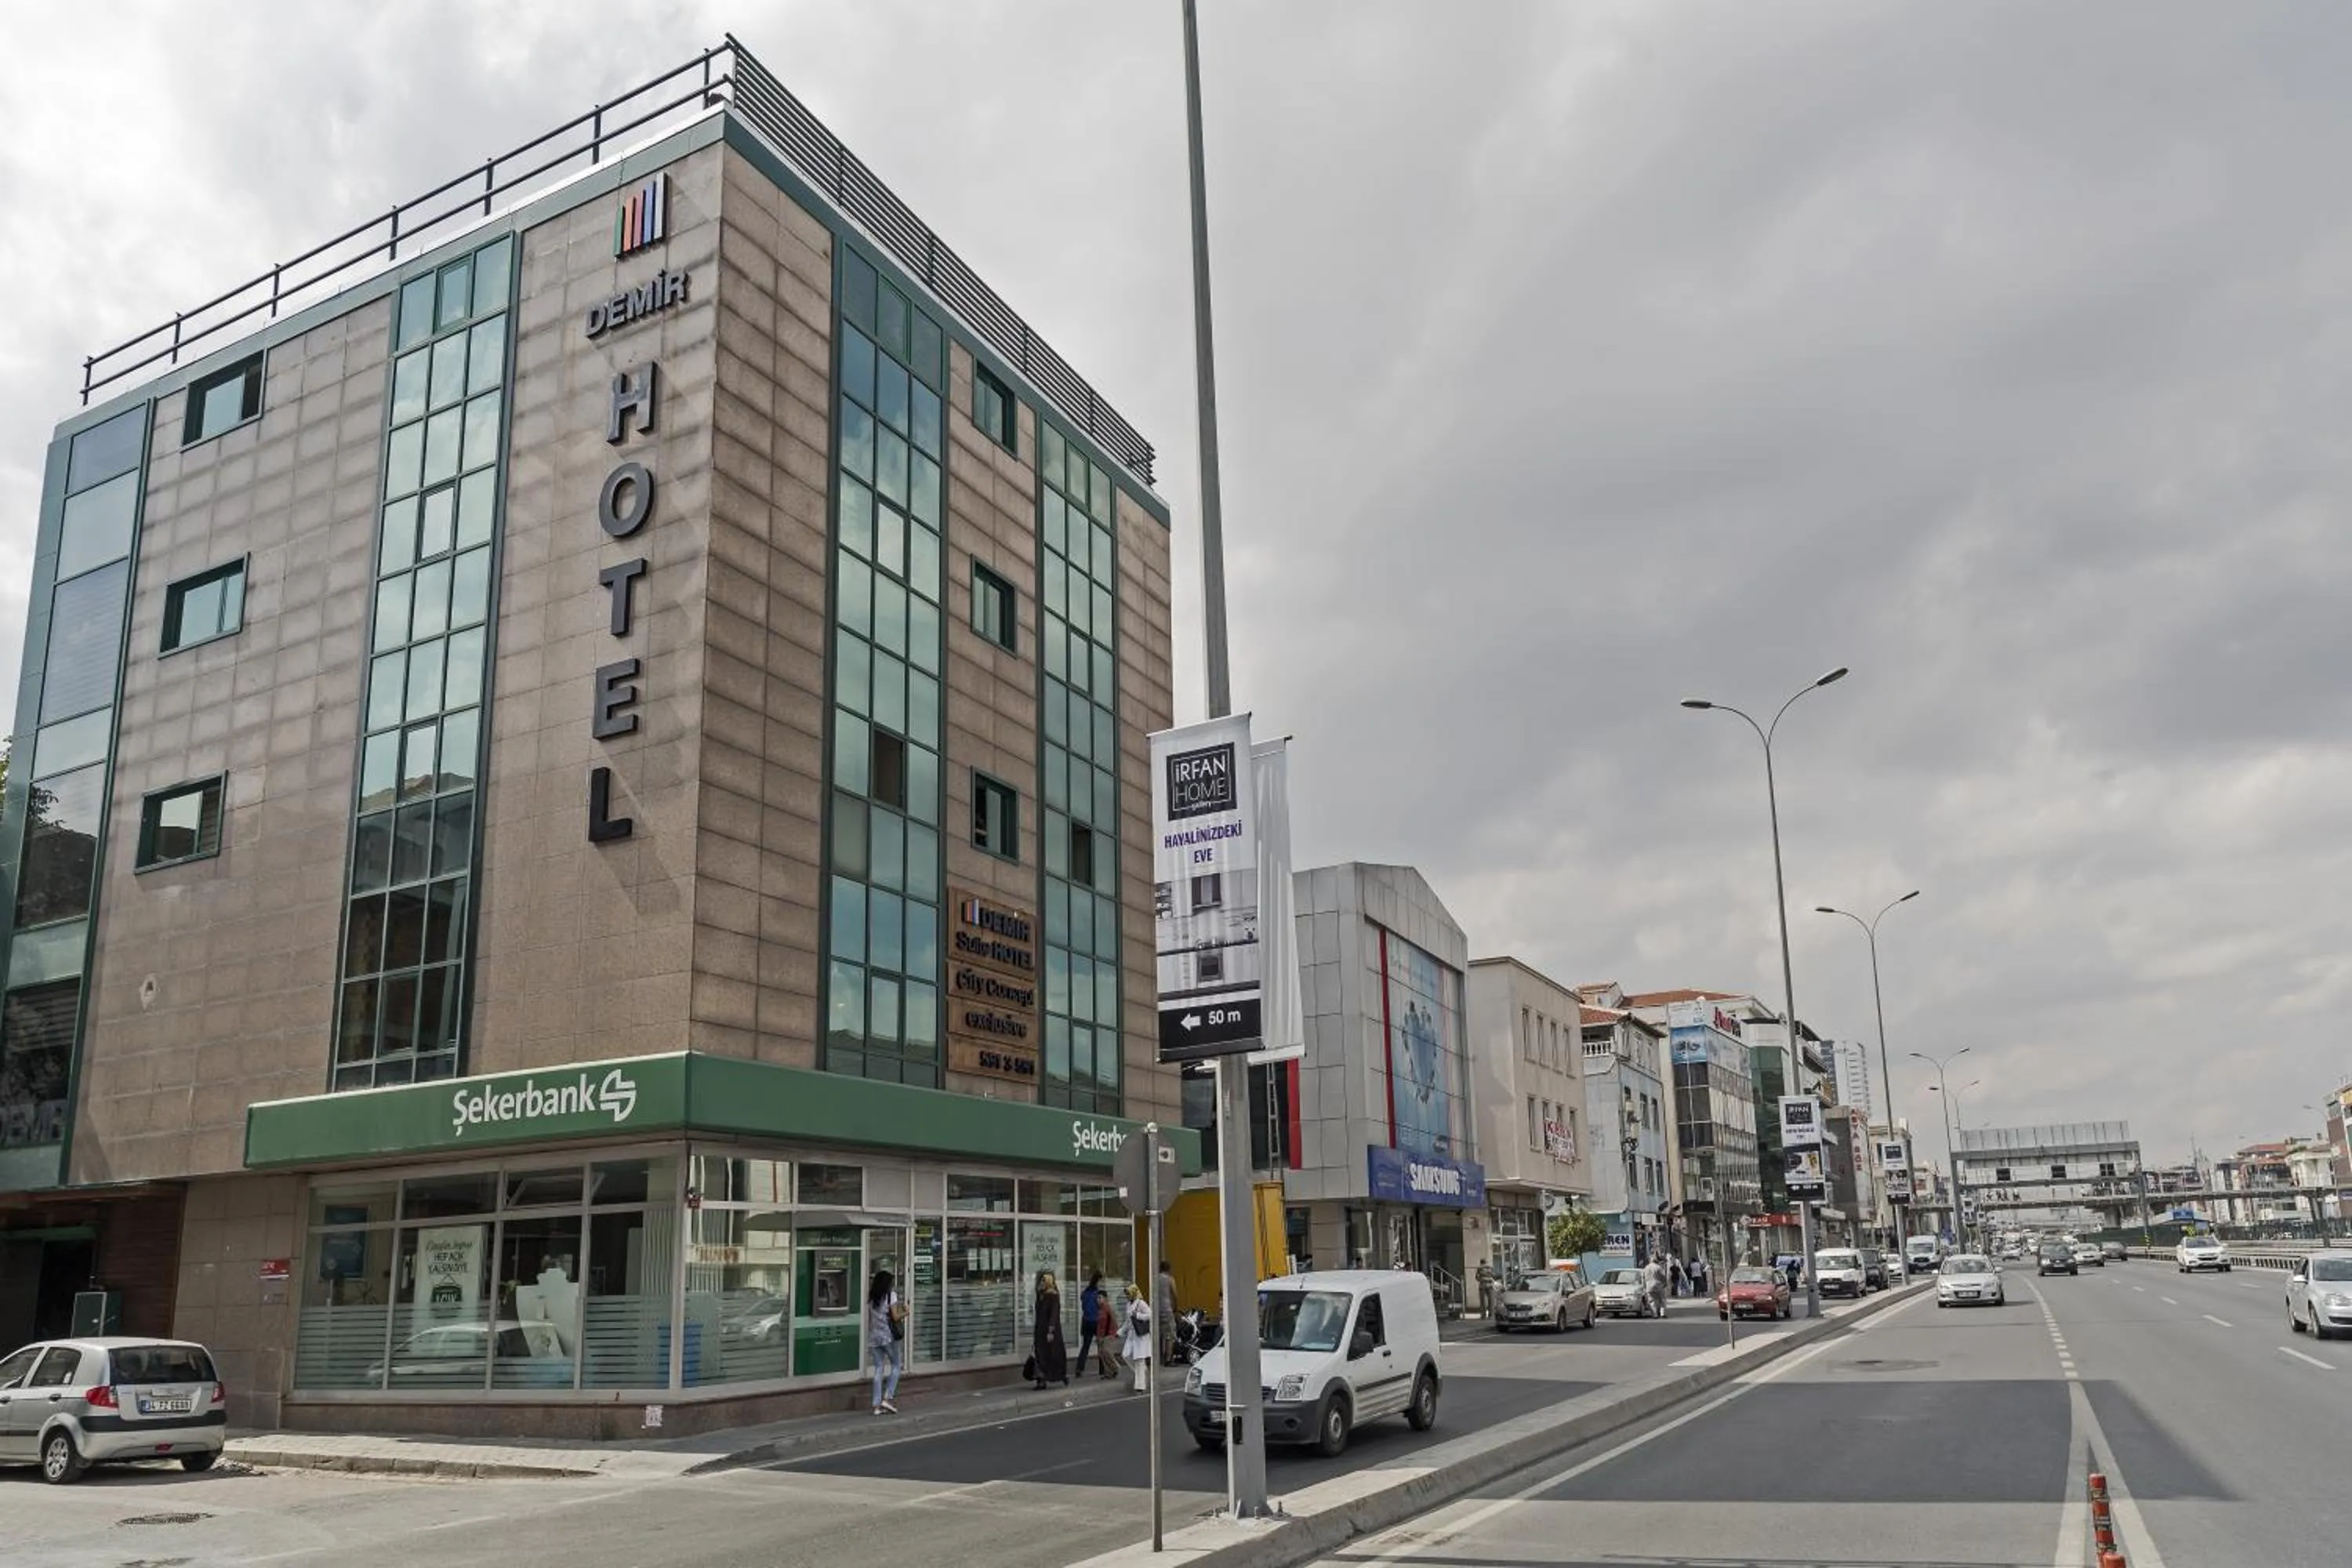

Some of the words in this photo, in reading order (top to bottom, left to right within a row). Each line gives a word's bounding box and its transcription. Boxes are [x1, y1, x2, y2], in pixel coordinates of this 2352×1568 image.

[586, 268, 690, 339] DEMİR
[588, 361, 657, 842] HOTEL
[1176, 755, 1225, 783] İRFAN
[1176, 778, 1227, 804] HOME
[1164, 819, 1242, 848] HAYALİNİZDEKİ
[1194, 848, 1213, 863] EVE
[1208, 1009, 1224, 1025] 50
[1228, 1010, 1241, 1023] m
[452, 1073, 596, 1136] Şekerbank
[1073, 1120, 1127, 1157] Şekerb
[1410, 1163, 1461, 1196] SAMSUNG
